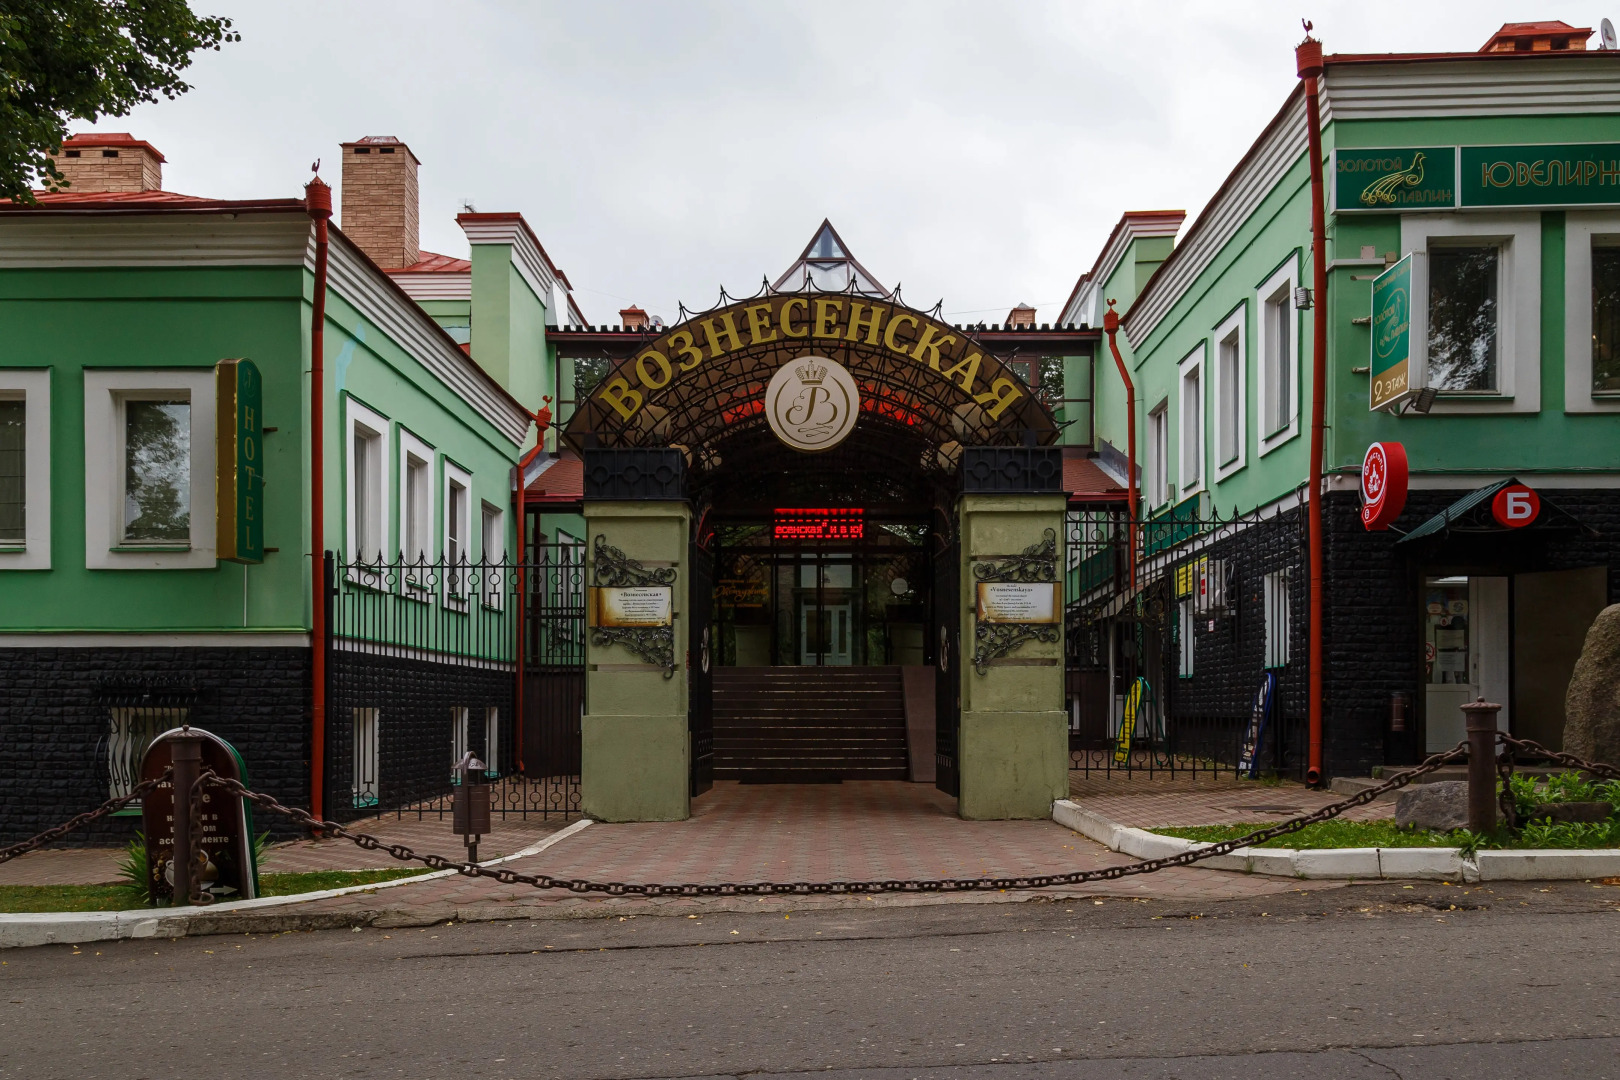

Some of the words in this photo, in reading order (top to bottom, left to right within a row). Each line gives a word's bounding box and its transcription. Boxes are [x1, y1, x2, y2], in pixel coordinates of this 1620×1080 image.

[1337, 157, 1402, 172] ЗОЛОТОЙ
[1482, 159, 1620, 188] ЮВЕЛИРН
[1397, 189, 1452, 204] ПАВЛИН
[598, 298, 1023, 423] ВОЗНЕСЕНСКАЯ
[1374, 380, 1383, 402] 2
[1385, 373, 1406, 395] ЭТАЖ
[244, 405, 255, 551] HOTEL
[1507, 492, 1532, 520] Б
[830, 525, 837, 534] и
[840, 525, 847, 534] в
